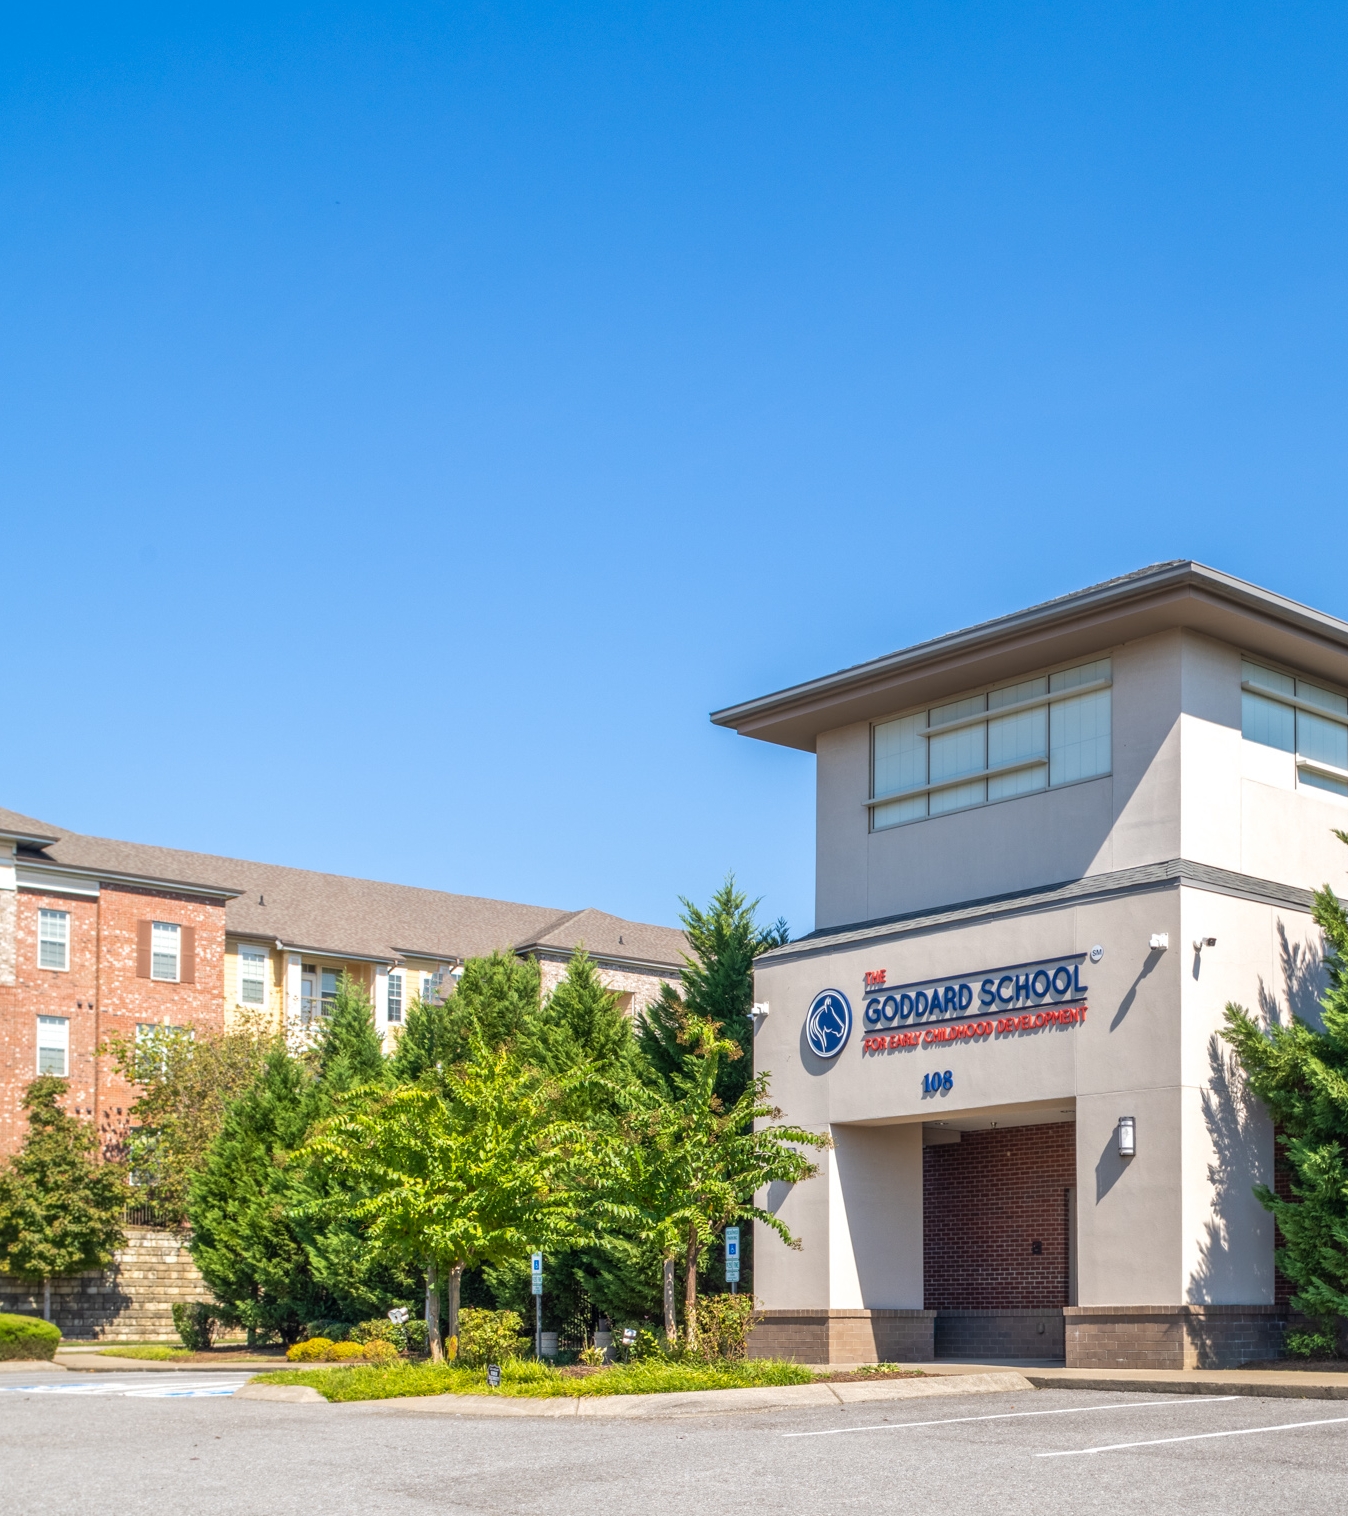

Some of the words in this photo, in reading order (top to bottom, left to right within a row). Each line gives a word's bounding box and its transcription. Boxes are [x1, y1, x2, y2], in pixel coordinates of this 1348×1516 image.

[1092, 948, 1102, 957] SM
[865, 969, 887, 985] THE
[865, 983, 973, 1024] GODDARD
[980, 964, 1089, 1006] SCHOOL
[864, 1036, 888, 1052] FOR
[889, 1031, 922, 1049] EARLY
[924, 1020, 995, 1044] CHILDHOOD
[997, 1005, 1089, 1033] DEVELOPMENT
[923, 1070, 954, 1093] 108
